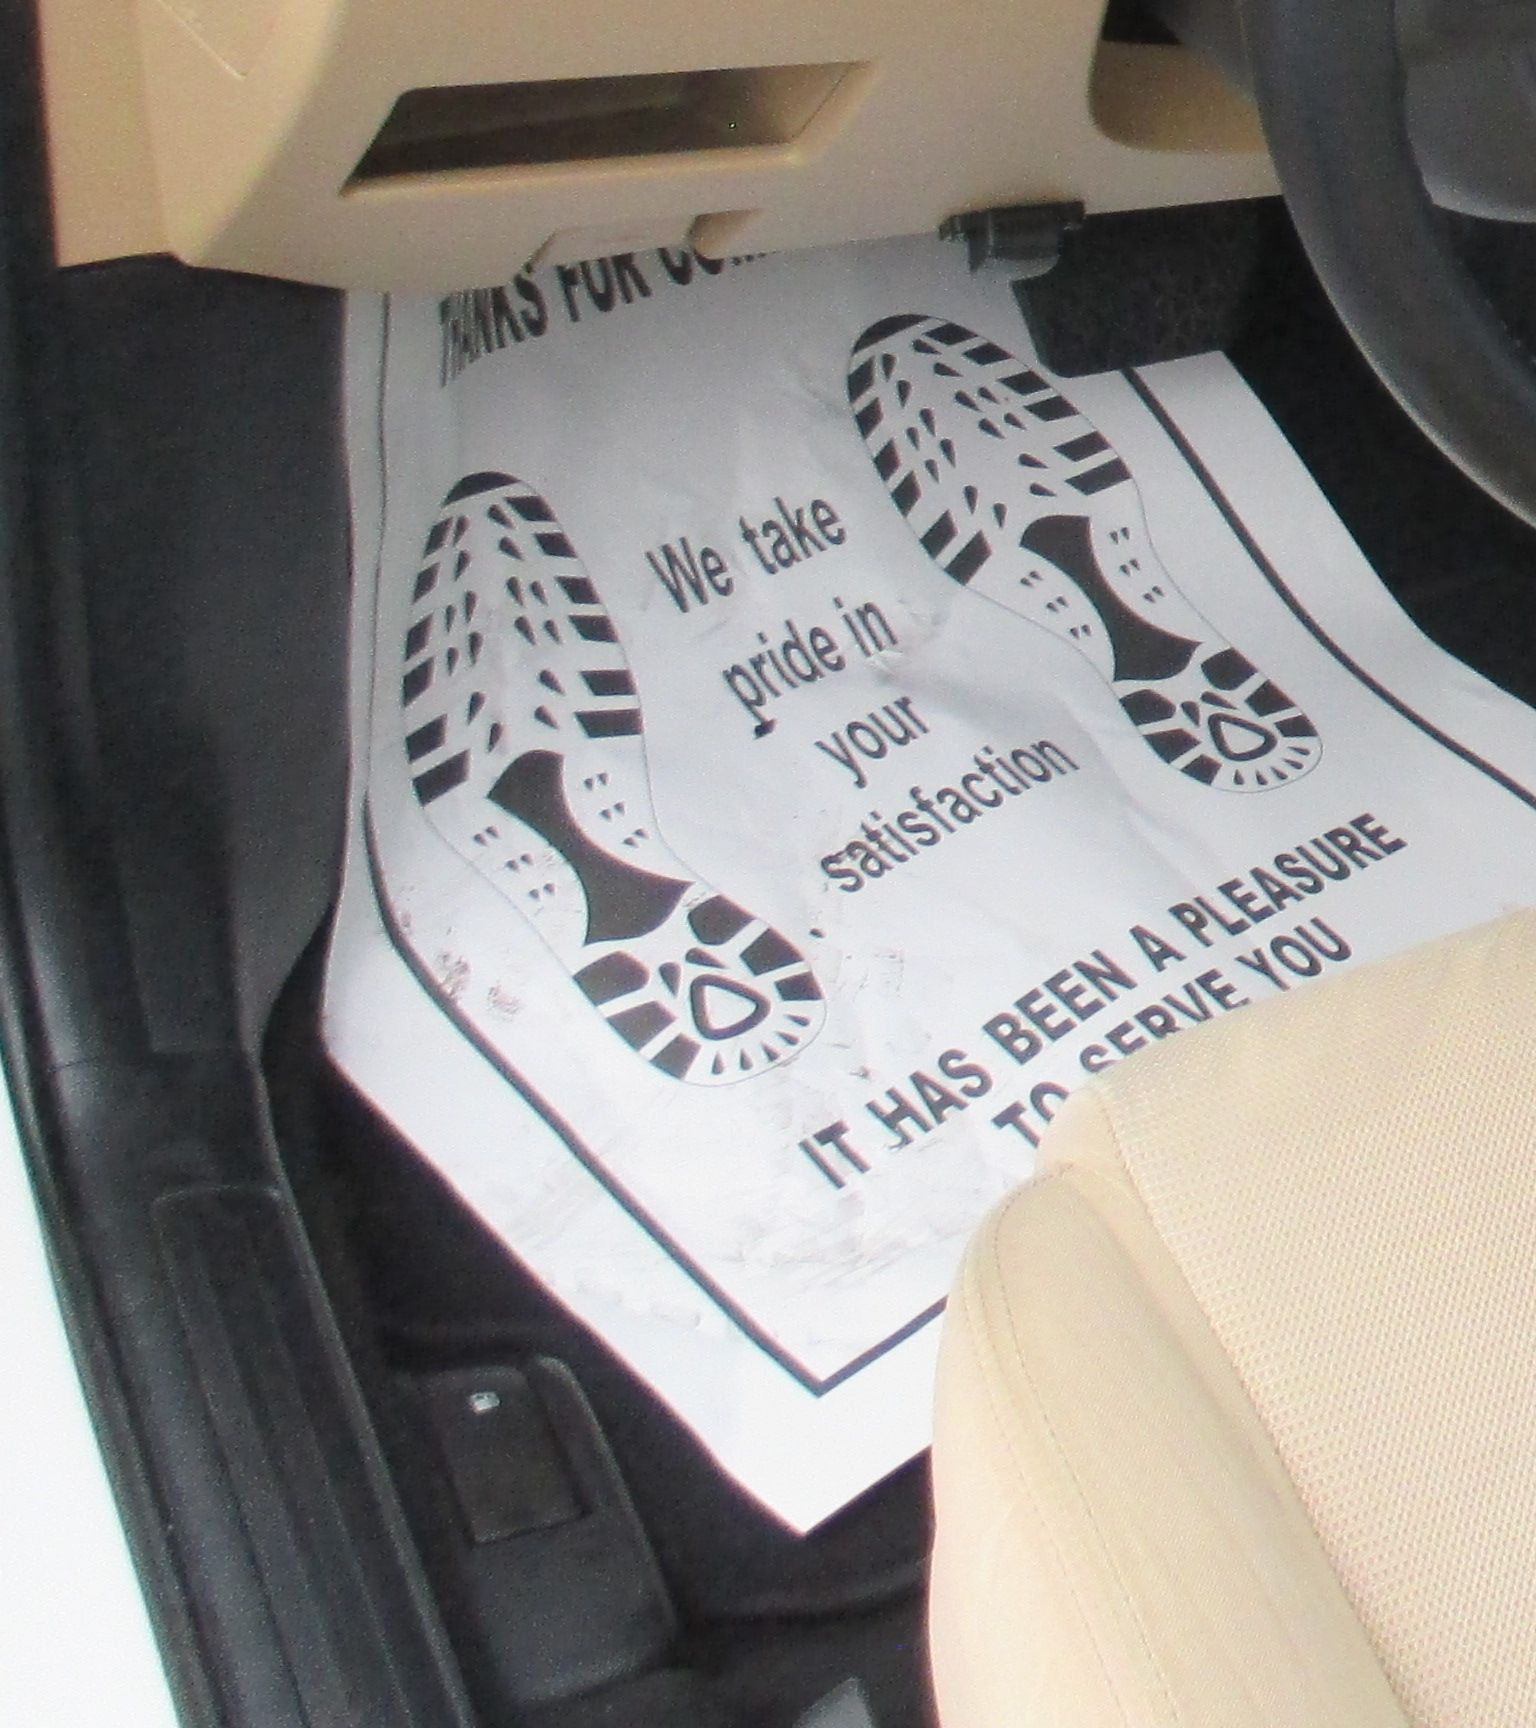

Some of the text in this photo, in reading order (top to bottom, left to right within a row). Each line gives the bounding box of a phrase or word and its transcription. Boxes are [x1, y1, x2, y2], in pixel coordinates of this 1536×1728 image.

[645, 497, 849, 614] We take
[721, 597, 901, 740] pride in
[816, 695, 931, 789] your
[820, 734, 1081, 894] satisfaction
[798, 812, 1409, 1190] IT HAS BEEN A PLEASURE
[1079, 968, 1253, 1074] SERVE
[1235, 916, 1354, 992] YOU
